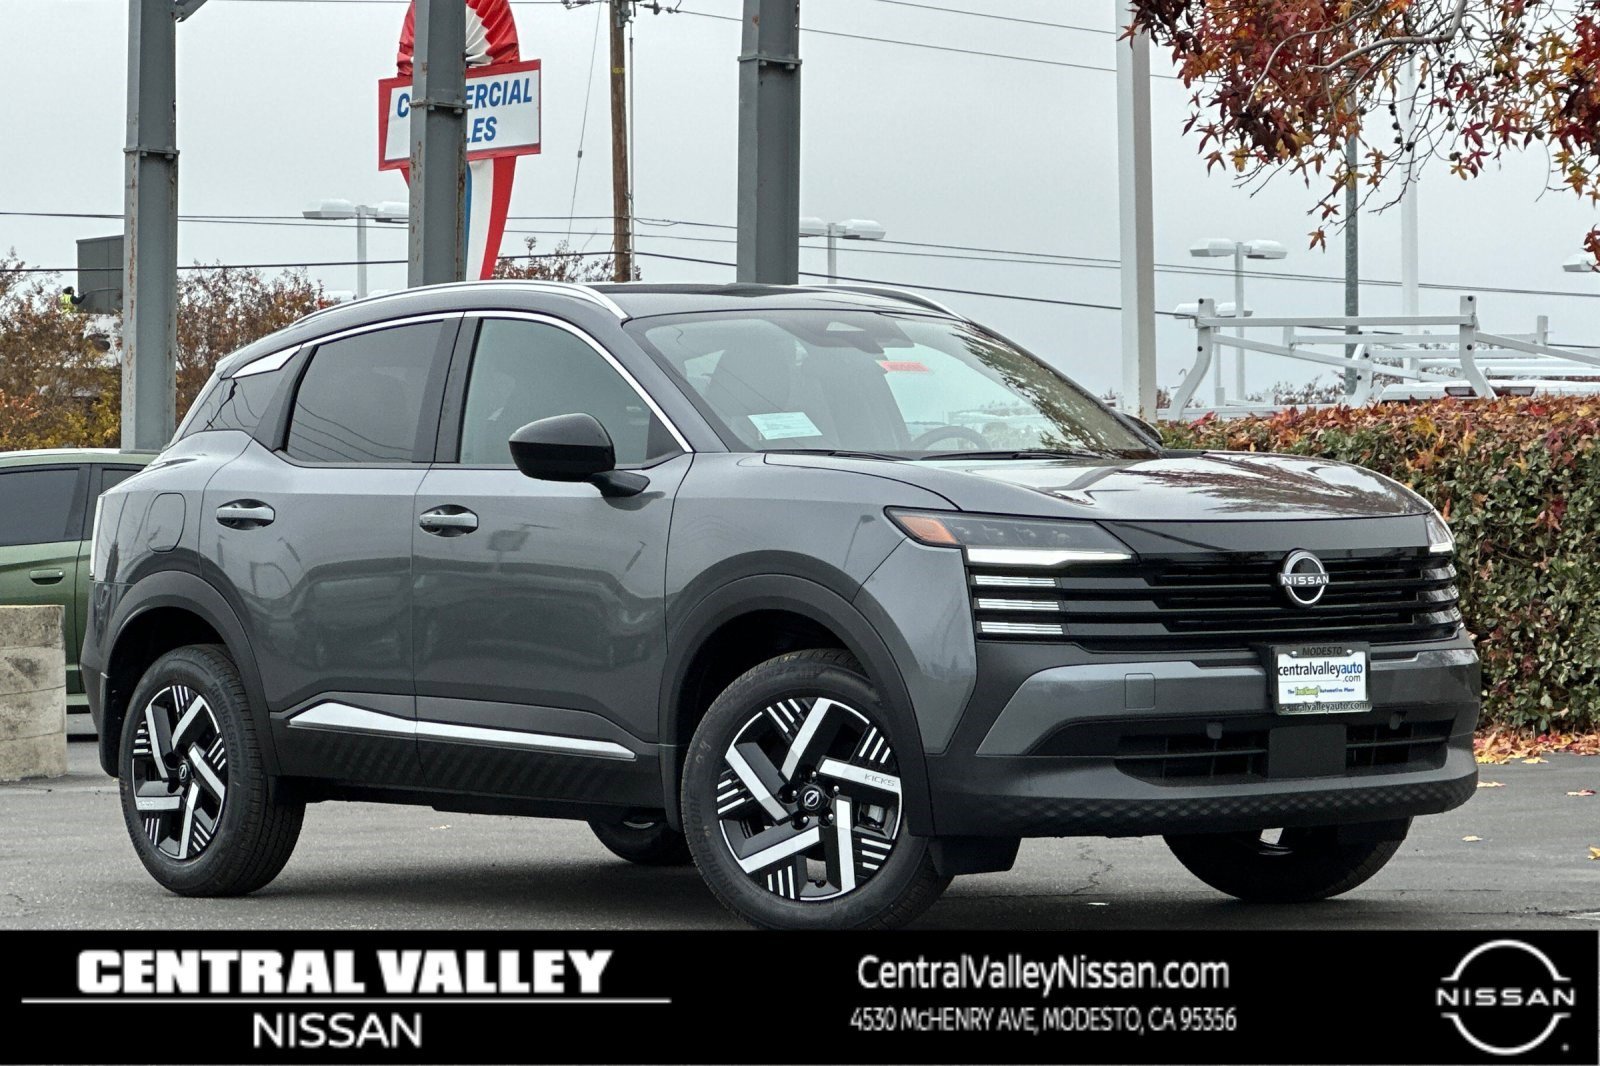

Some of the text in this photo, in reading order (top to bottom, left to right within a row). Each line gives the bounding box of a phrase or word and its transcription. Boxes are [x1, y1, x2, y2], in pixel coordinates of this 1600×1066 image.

[397, 78, 532, 117] CERCIAL
[1282, 575, 1329, 585] NISSAN
[1302, 646, 1343, 656] MODESTO
[1278, 661, 1363, 678] centralvalleyauto
[1342, 674, 1361, 683] .com
[864, 773, 895, 787] KICKS
